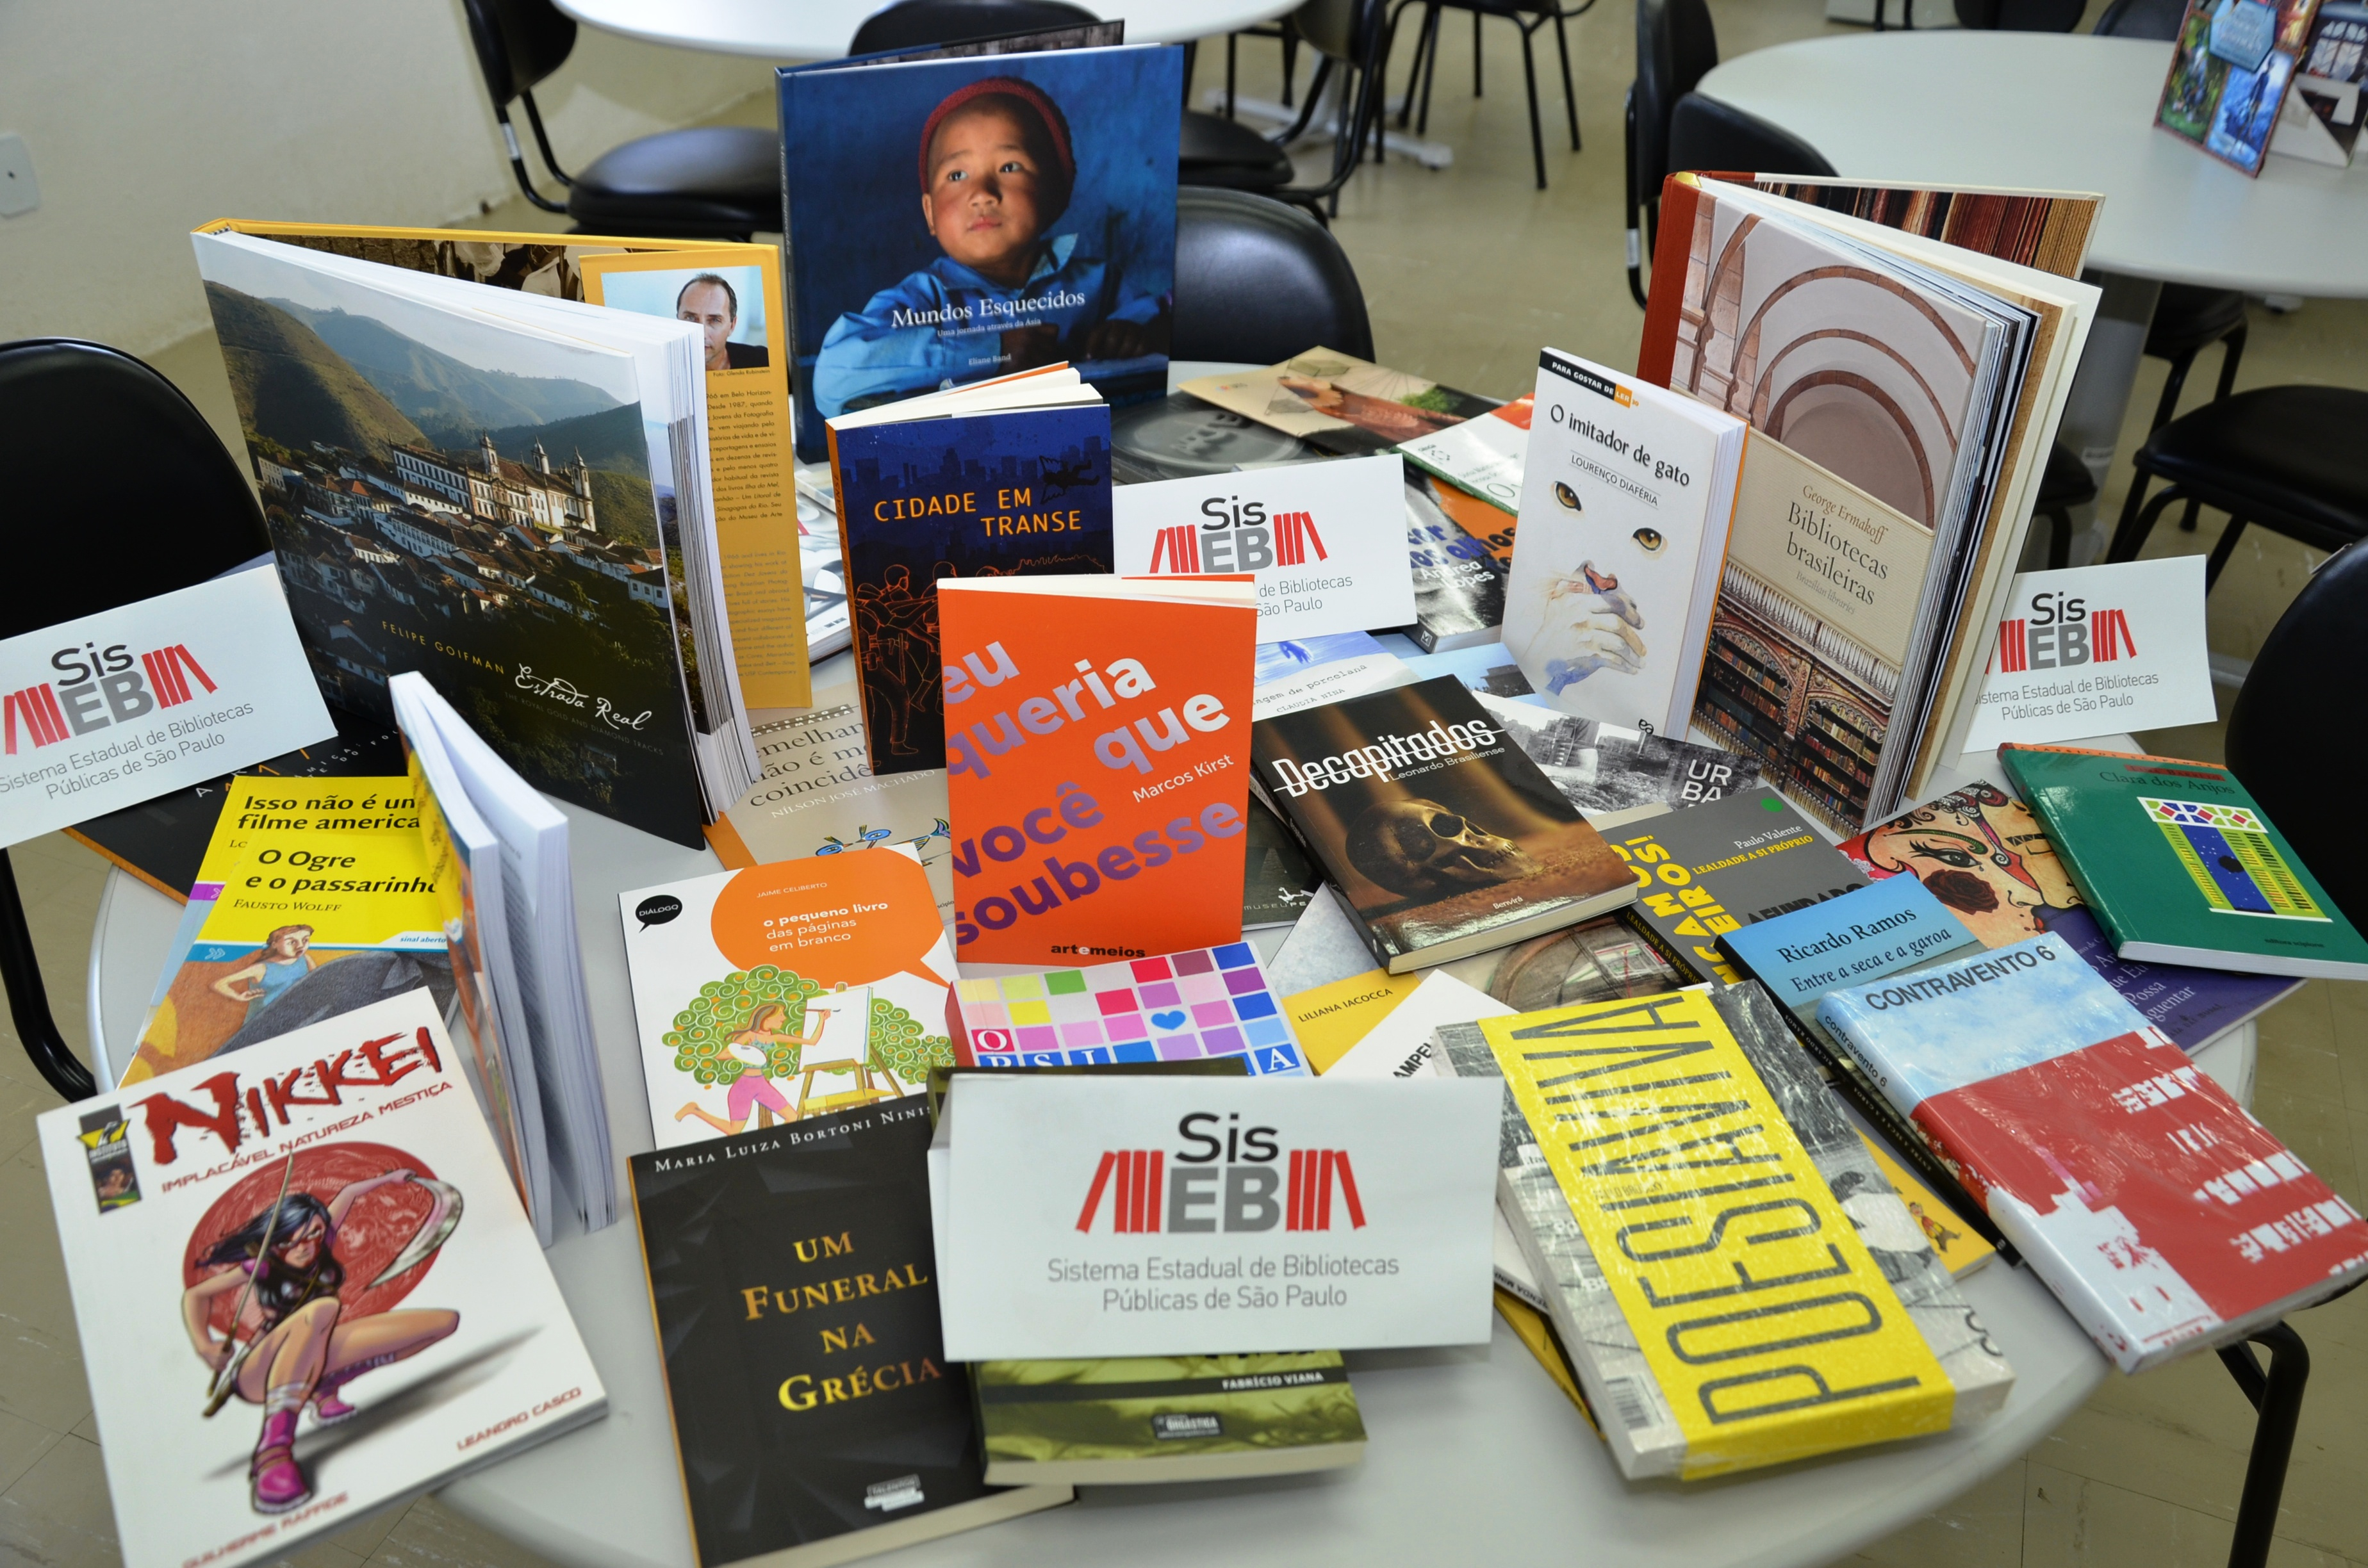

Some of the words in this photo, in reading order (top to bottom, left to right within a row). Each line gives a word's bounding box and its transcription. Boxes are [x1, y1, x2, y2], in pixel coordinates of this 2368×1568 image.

[891, 301, 974, 329] Mundos
[979, 290, 1087, 318] Esquecidos
[937, 327, 955, 338] Uma
[957, 324, 985, 337] jornada
[987, 320, 1013, 331] através
[968, 355, 989, 366] Eliane
[989, 353, 1012, 364] Band
[1552, 361, 1571, 375] PARA
[1573, 369, 1602, 389] GOSTAR
[1603, 383, 1615, 395] DE
[1615, 389, 1631, 404] LER
[750, 400, 773, 408] quando
[1550, 404, 1565, 422] O
[1568, 412, 1629, 457] imitador
[1632, 444, 1652, 468] de
[1654, 459, 1691, 487] gato
[1570, 454, 1618, 484] LOURENÇO
[1618, 477, 1659, 507] DIAFÉRIA
[874, 492, 977, 522] CIDADE
[998, 487, 1032, 510] EM
[1201, 494, 1267, 531] Sis
[1802, 484, 1837, 516] George
[1837, 503, 1889, 546] Ermakoff
[980, 510, 1082, 538] TRANSE
[1788, 500, 1889, 581] Bibliotecas
[1201, 525, 1274, 573] EB
[1418, 560, 1483, 581] Andrea
[1440, 570, 1495, 590] Lopes
[1786, 530, 1875, 605] brasileiras
[1258, 581, 1276, 598] de
[1279, 575, 1353, 596] Bibliotecas
[1795, 570, 1827, 601] Brazilian
[1827, 589, 1856, 616] libraries
[1283, 596, 1323, 614] Paulo
[2029, 591, 2087, 626] Sis
[51, 641, 135, 687] Sis
[382, 620, 427, 646] FELIPE
[434, 640, 506, 676] GOIFMAN
[2028, 623, 2091, 671] EB
[943, 641, 1021, 705] eu
[1288, 687, 1303, 696] de
[1306, 664, 1368, 690] porcelana
[2022, 679, 2076, 701] Estadual
[2077, 678, 2093, 694] de
[2094, 671, 2160, 692] Bibliotecas
[58, 670, 154, 737] EB
[514, 662, 589, 709] Estrada
[596, 696, 654, 732] Real
[1276, 697, 1318, 714] CLAUDIA
[1320, 687, 1346, 700] NINA
[2001, 701, 2054, 721] Públicas
[2055, 698, 2072, 715] de
[2074, 694, 2097, 712] São
[2098, 692, 2134, 710] Paulo
[547, 706, 569, 721] GOLD
[590, 722, 630, 745] DIAMOND
[632, 738, 665, 757] TRACKS
[947, 657, 1157, 780] queria
[1093, 693, 1231, 775] que
[0, 760, 68, 794] Sistema
[69, 734, 145, 771] Estadual
[145, 730, 167, 747] de
[167, 701, 255, 739] Bibliotecas
[45, 765, 120, 800] Públicas
[122, 760, 143, 775] de
[144, 747, 177, 767] São
[178, 731, 226, 757] Paulo
[809, 751, 826, 767] é
[1272, 719, 1504, 798] Decapitados
[1388, 758, 1445, 781] Leonardo
[1447, 746, 1506, 769] Brasiliense
[1132, 771, 1194, 803] Marcos
[1194, 753, 1235, 778] Kirst
[1688, 759, 1732, 787] UR
[2099, 771, 2149, 787] Clara
[2151, 776, 2182, 789] dos
[2187, 779, 2236, 796] Anjos
[244, 795, 299, 811] Isso
[306, 794, 354, 810] não
[361, 794, 377, 810] é
[770, 797, 827, 819] NÍLSON
[830, 787, 863, 804] JOSÉ
[863, 769, 935, 794] MACHADO
[1681, 780, 1722, 803] BA
[238, 813, 308, 830] filme
[952, 780, 1105, 879] você
[1733, 835, 1764, 849] Paulo
[1762, 824, 1804, 841] Valente
[258, 849, 281, 865] O
[288, 850, 356, 872] Ogre
[957, 801, 1246, 946] soubesse
[1691, 854, 1748, 876] LEALDADE
[1747, 852, 1758, 860] A
[1755, 847, 1769, 858] SI
[1767, 835, 1814, 854] PRÓPRIO
[245, 875, 261, 888] e
[268, 876, 286, 890] o
[756, 888, 782, 899] JAIME
[783, 882, 828, 895] CELIBERTO
[233, 898, 289, 911] FAUSTO
[293, 901, 342, 912] WOLFF
[638, 902, 679, 917] DIÁLOGO
[762, 919, 773, 928] o
[778, 906, 850, 926] pequeno
[852, 901, 889, 915] livro
[1492, 895, 1524, 911] Benvirá
[420, 935, 447, 943] aberto
[766, 926, 793, 940] das
[797, 918, 857, 939] páginas
[769, 940, 793, 952] em
[798, 931, 851, 948] branco
[1776, 927, 1852, 963] Ricardo
[1852, 906, 1918, 943] Ramos
[1050, 943, 1146, 959] artemeios
[1790, 968, 1837, 994] Entre
[1839, 967, 1850, 981] a
[1854, 952, 1885, 976] seca
[1886, 948, 1896, 962] e
[1896, 944, 1908, 959] a
[1909, 927, 1952, 961] garoa
[1865, 950, 2037, 1012] CONTRAVENTO
[2036, 944, 2057, 966] 6
[2119, 962, 2150, 979] Eu
[1297, 996, 1341, 1023] LILIANA
[1342, 986, 1394, 1008] IACOCCA
[2122, 981, 2167, 1006] Possa
[1825, 1015, 1879, 1078] contravento
[1880, 1076, 1888, 1088] 6
[127, 1026, 443, 1166] NIKKEI
[161, 1148, 276, 1194] IMPLACÁVEL
[279, 1109, 375, 1155] NATUREZA
[378, 1080, 453, 1117] MESTIÇA
[654, 1153, 716, 1173] MARIA
[725, 1139, 782, 1159] LUIZA
[789, 1118, 872, 1146] BORTONI
[1174, 1111, 1281, 1165] Sis
[1166, 1166, 1281, 1234] EB
[793, 1230, 855, 1264] UM
[1047, 1257, 1140, 1284] Sistema
[1146, 1255, 1244, 1282] Estadual
[1248, 1256, 1278, 1279] de
[1283, 1253, 1401, 1278] Bibliotecas
[740, 1262, 928, 1322] FUNERAL
[1102, 1284, 1199, 1316] Públicas
[1204, 1287, 1233, 1311] de
[1237, 1284, 1279, 1310] São
[1285, 1282, 1349, 1308] Paulo
[819, 1322, 876, 1355] NA
[777, 1356, 943, 1412] GRÉCIA
[1222, 1375, 1281, 1391] FABRÍCIO
[1283, 1370, 1324, 1385] VIANA
[457, 1412, 530, 1452] LEANDRO
[531, 1387, 584, 1426] CASCO
